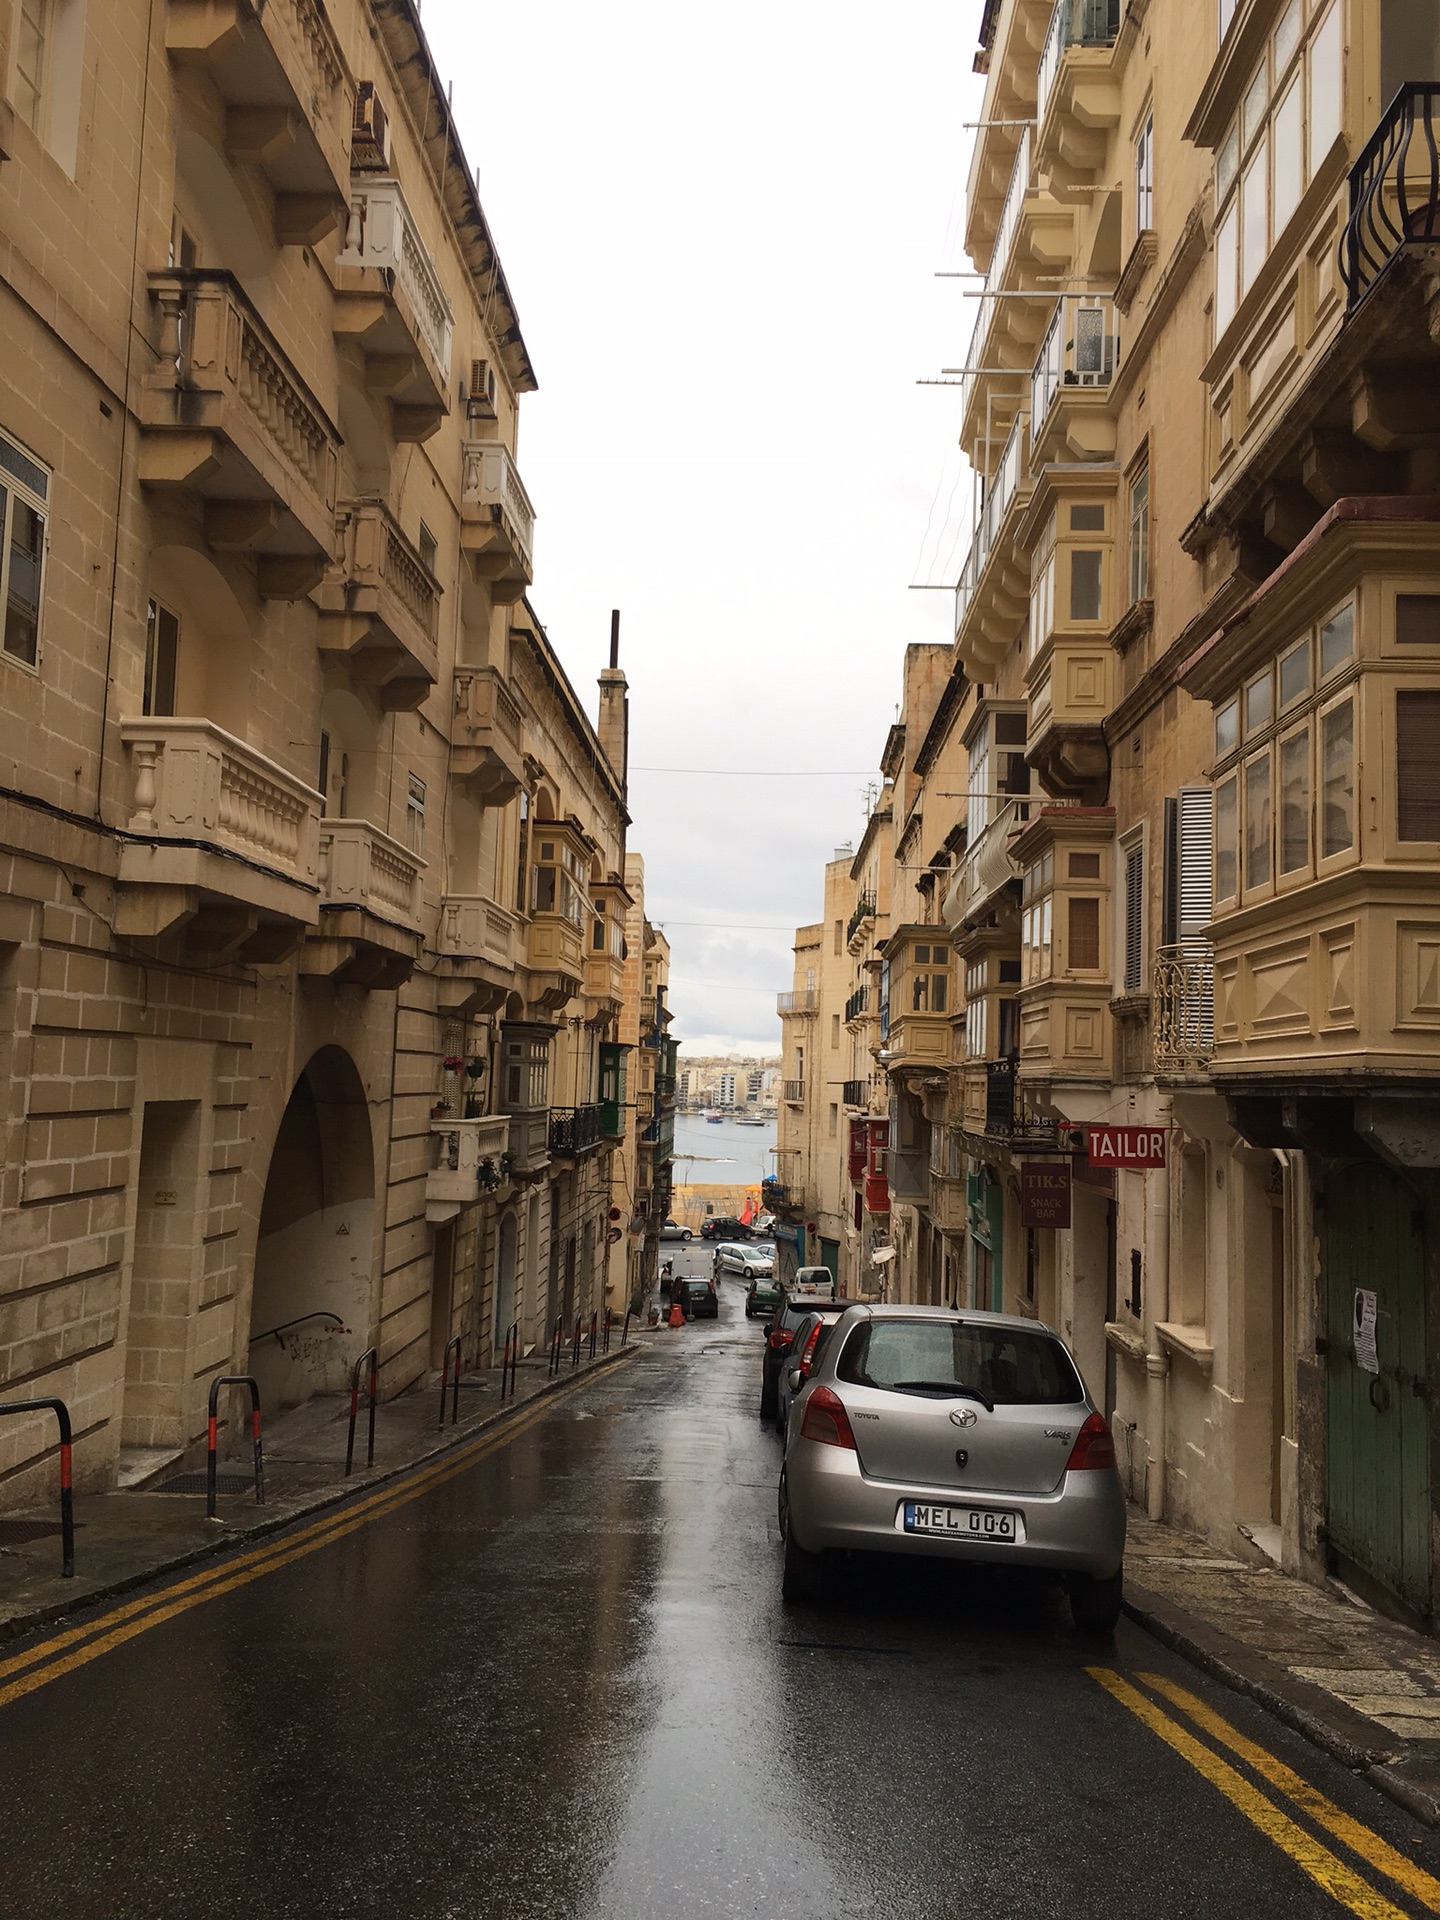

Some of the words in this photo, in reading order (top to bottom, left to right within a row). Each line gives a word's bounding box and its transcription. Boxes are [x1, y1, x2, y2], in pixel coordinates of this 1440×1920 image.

[1090, 1133, 1163, 1158] TAILOR
[1030, 1197, 1062, 1209] SNACK
[1036, 1209, 1056, 1219] BAR
[853, 1411, 880, 1421] TOYOTA
[1043, 1429, 1071, 1440] YARIS
[917, 1507, 958, 1529] MEL
[969, 1512, 1010, 1534] 006
